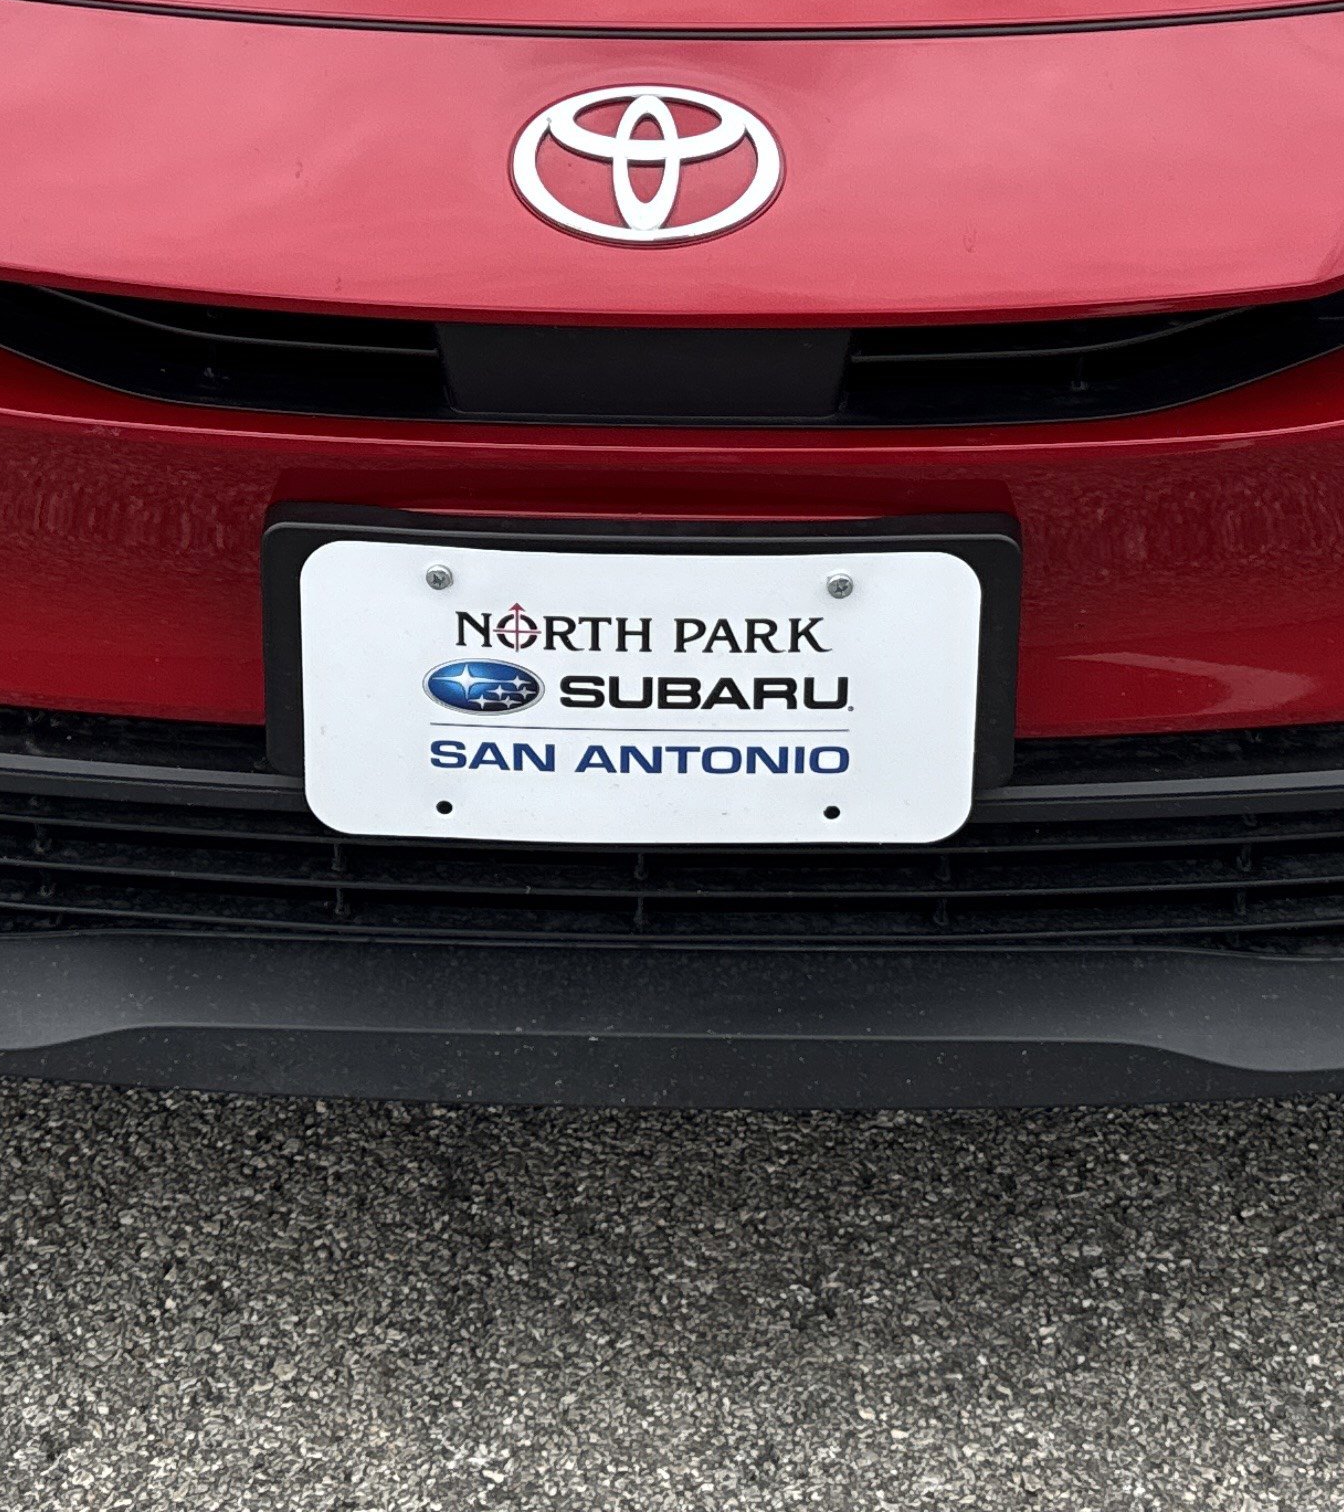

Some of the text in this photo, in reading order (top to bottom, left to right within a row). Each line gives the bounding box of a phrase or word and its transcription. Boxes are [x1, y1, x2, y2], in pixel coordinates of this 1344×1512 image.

[456, 605, 833, 654] NORTH PARK
[559, 675, 850, 710] SUBARU
[430, 740, 850, 775] SAN ANTONIO
